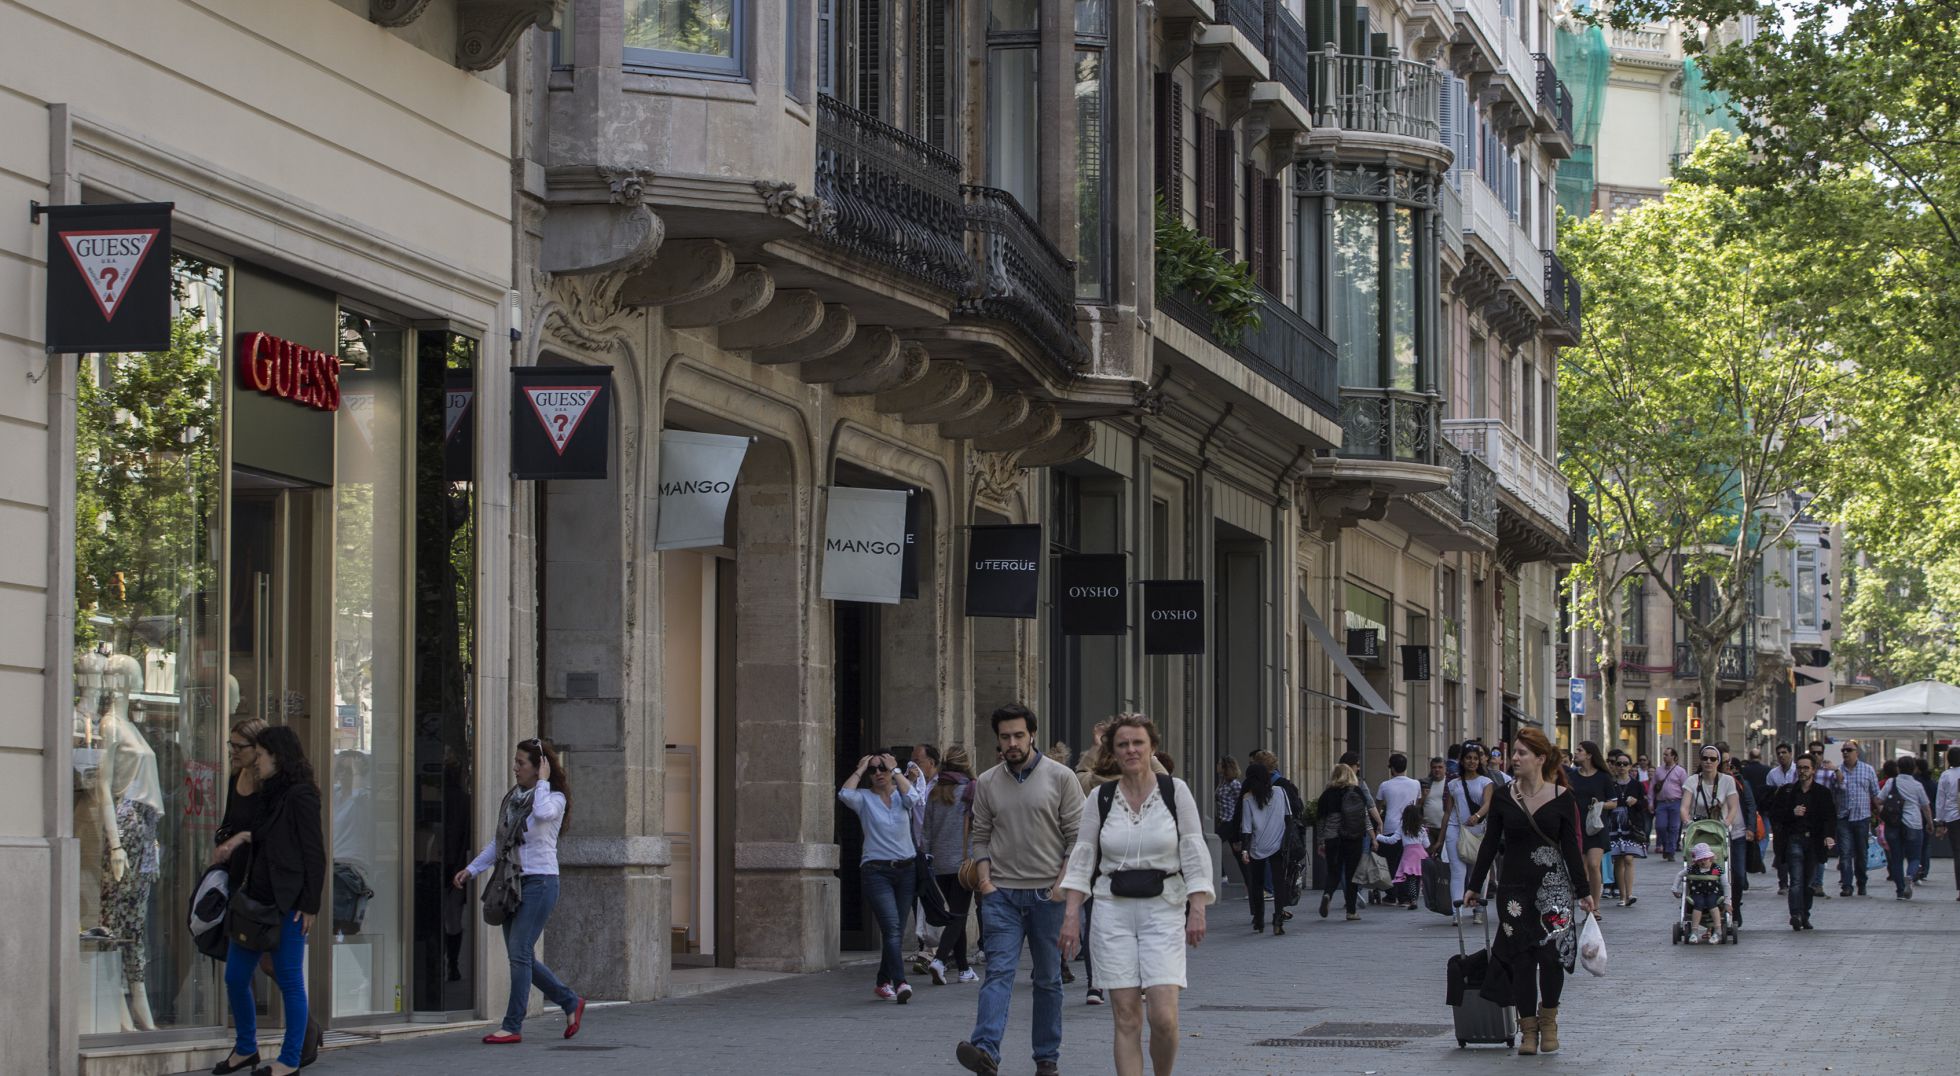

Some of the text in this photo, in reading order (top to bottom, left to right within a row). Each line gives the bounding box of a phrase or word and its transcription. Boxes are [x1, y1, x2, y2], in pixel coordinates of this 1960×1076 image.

[76, 238, 141, 257] GUESS
[248, 332, 340, 411] GUESS
[536, 392, 586, 407] GUESS
[659, 480, 730, 496] MANGO
[906, 533, 915, 544] E
[826, 538, 901, 556] MANGO
[975, 559, 1037, 571] UTERQÜE
[1069, 586, 1119, 598] OYSHO
[1151, 609, 1197, 621] OYSHO
[1621, 712, 1640, 721] OLE
